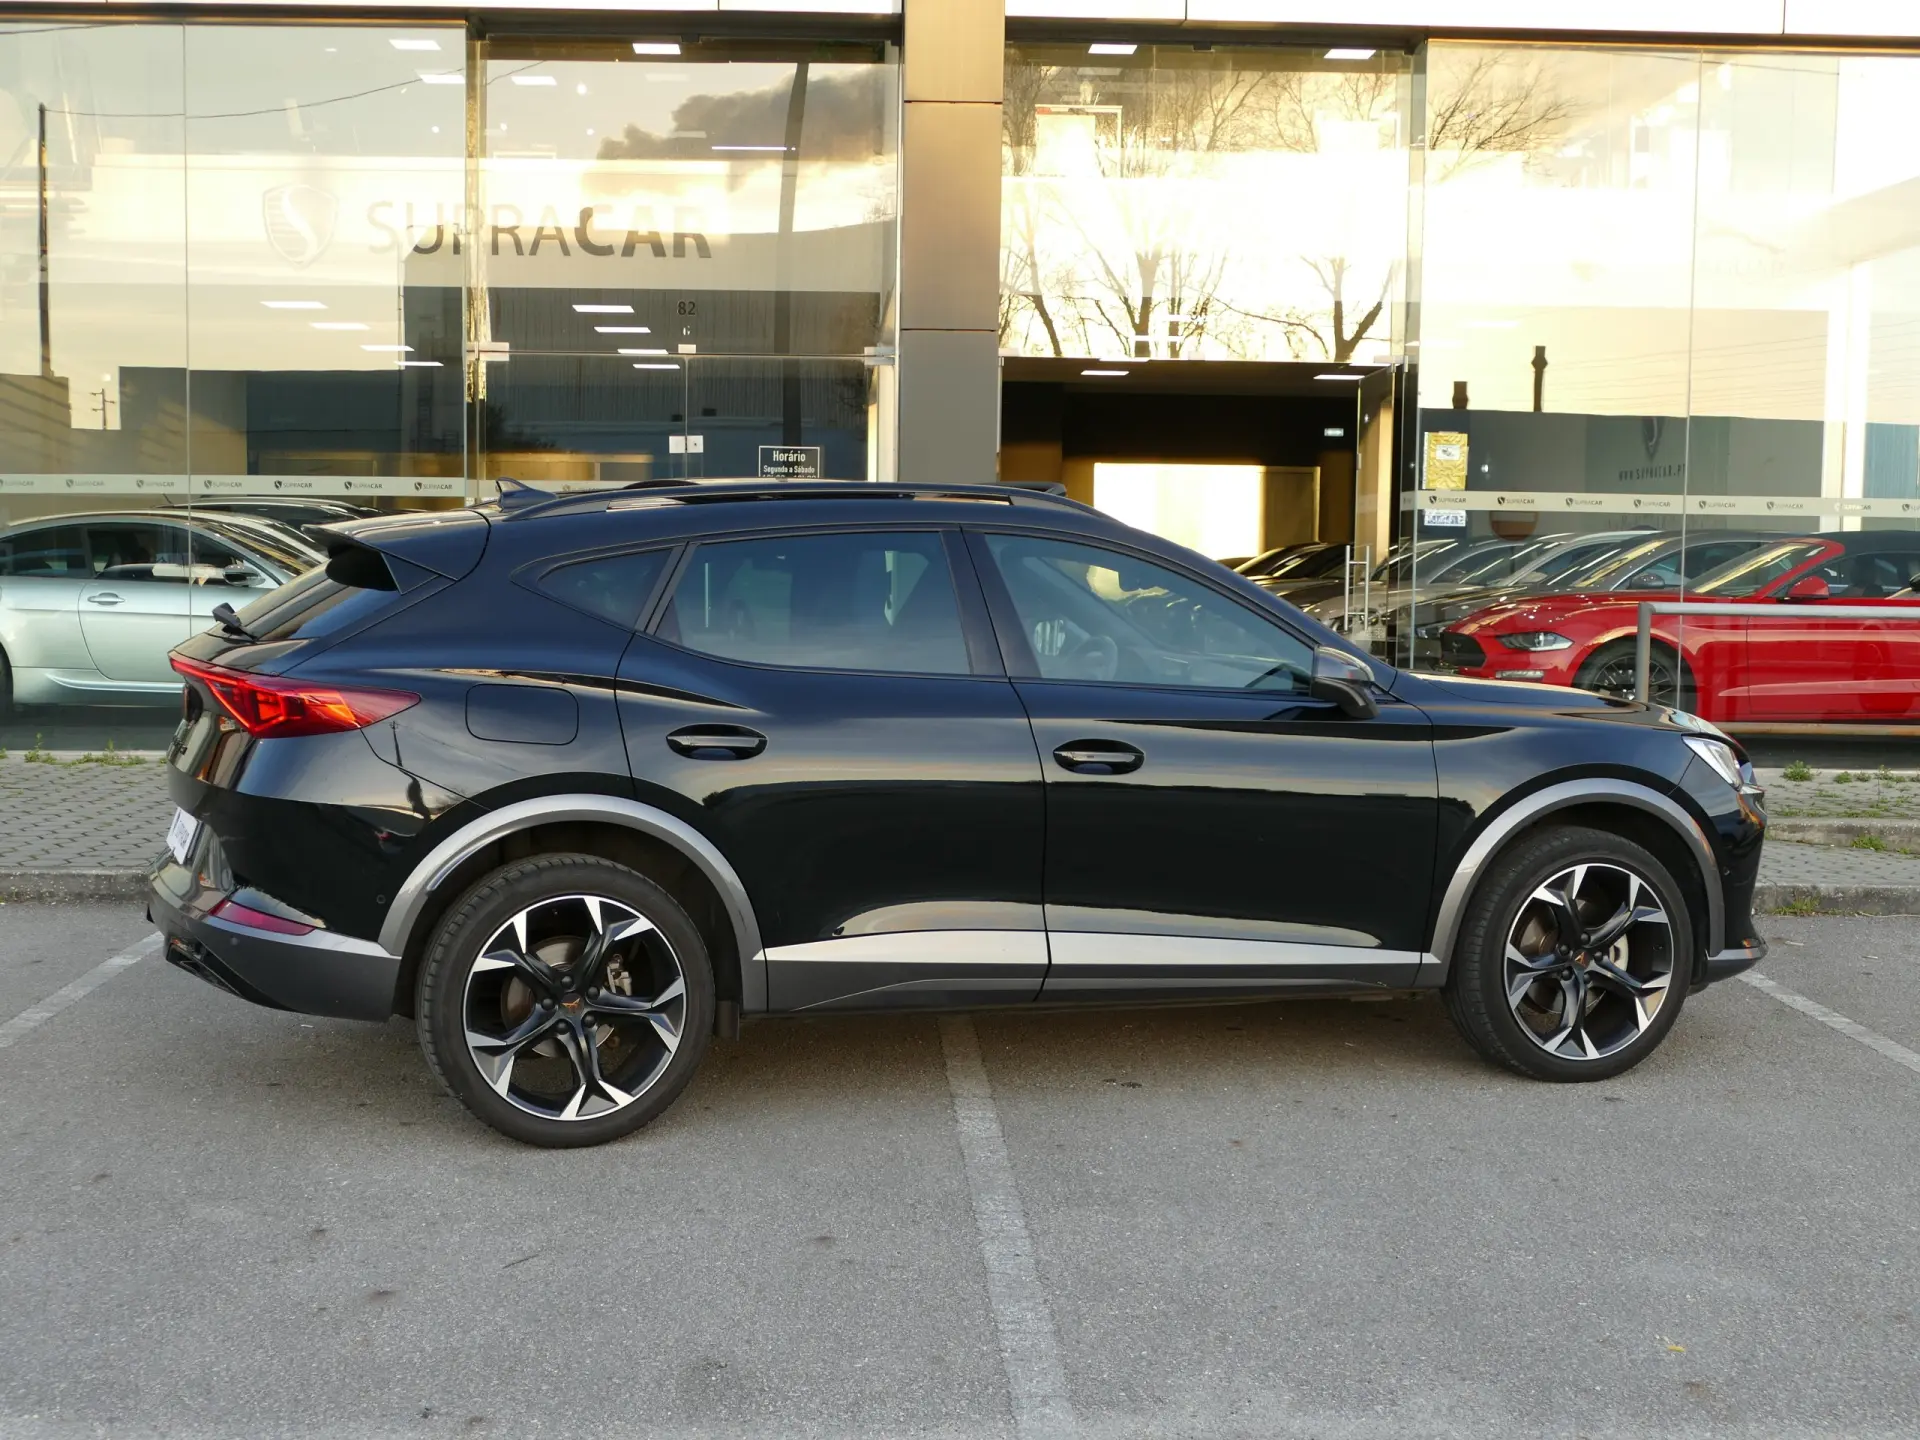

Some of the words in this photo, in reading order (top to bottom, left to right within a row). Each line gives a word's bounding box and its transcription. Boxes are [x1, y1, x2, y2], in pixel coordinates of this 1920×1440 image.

[367, 200, 712, 259] SUPRACAR
[678, 301, 696, 316] 82
[772, 450, 806, 462] Horário
[763, 465, 788, 474] Segunda
[794, 465, 815, 473] Sábado
